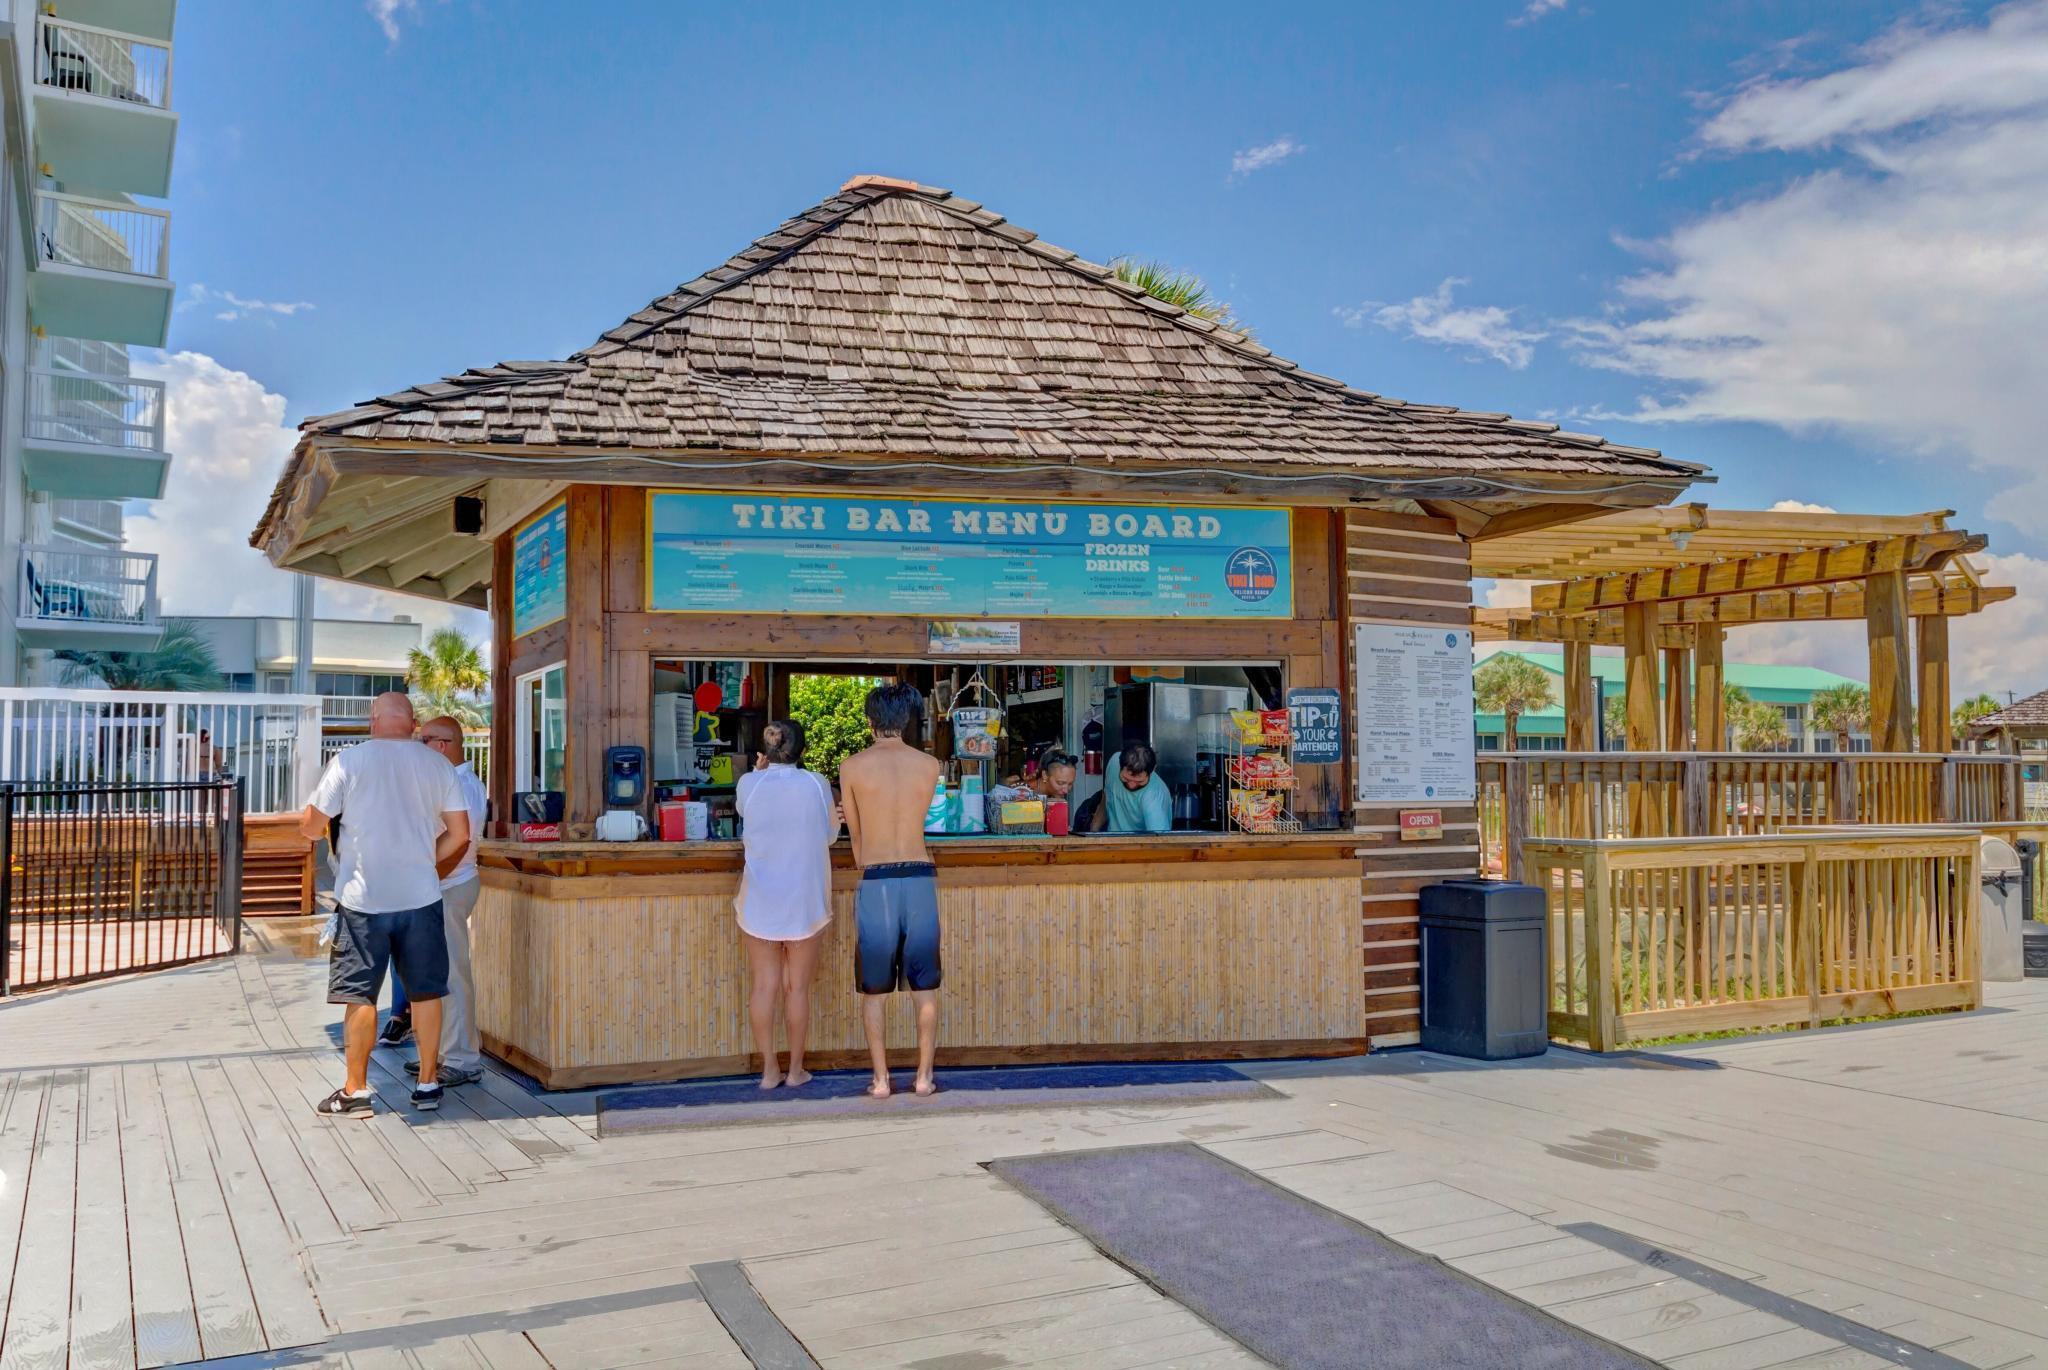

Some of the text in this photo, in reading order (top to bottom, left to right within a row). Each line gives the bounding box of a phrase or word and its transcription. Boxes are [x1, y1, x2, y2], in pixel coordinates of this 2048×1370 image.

[732, 503, 1221, 539] TIKI BAR MENU BOARD
[1084, 543, 1150, 557] FROZEN
[1085, 559, 1150, 573] DRINKS
[960, 711, 986, 720] TIPS
[1288, 706, 1320, 728] TIP
[1302, 728, 1326, 741] YOUR
[1292, 741, 1339, 752] BARTENDER
[1409, 815, 1434, 826] OPEN
